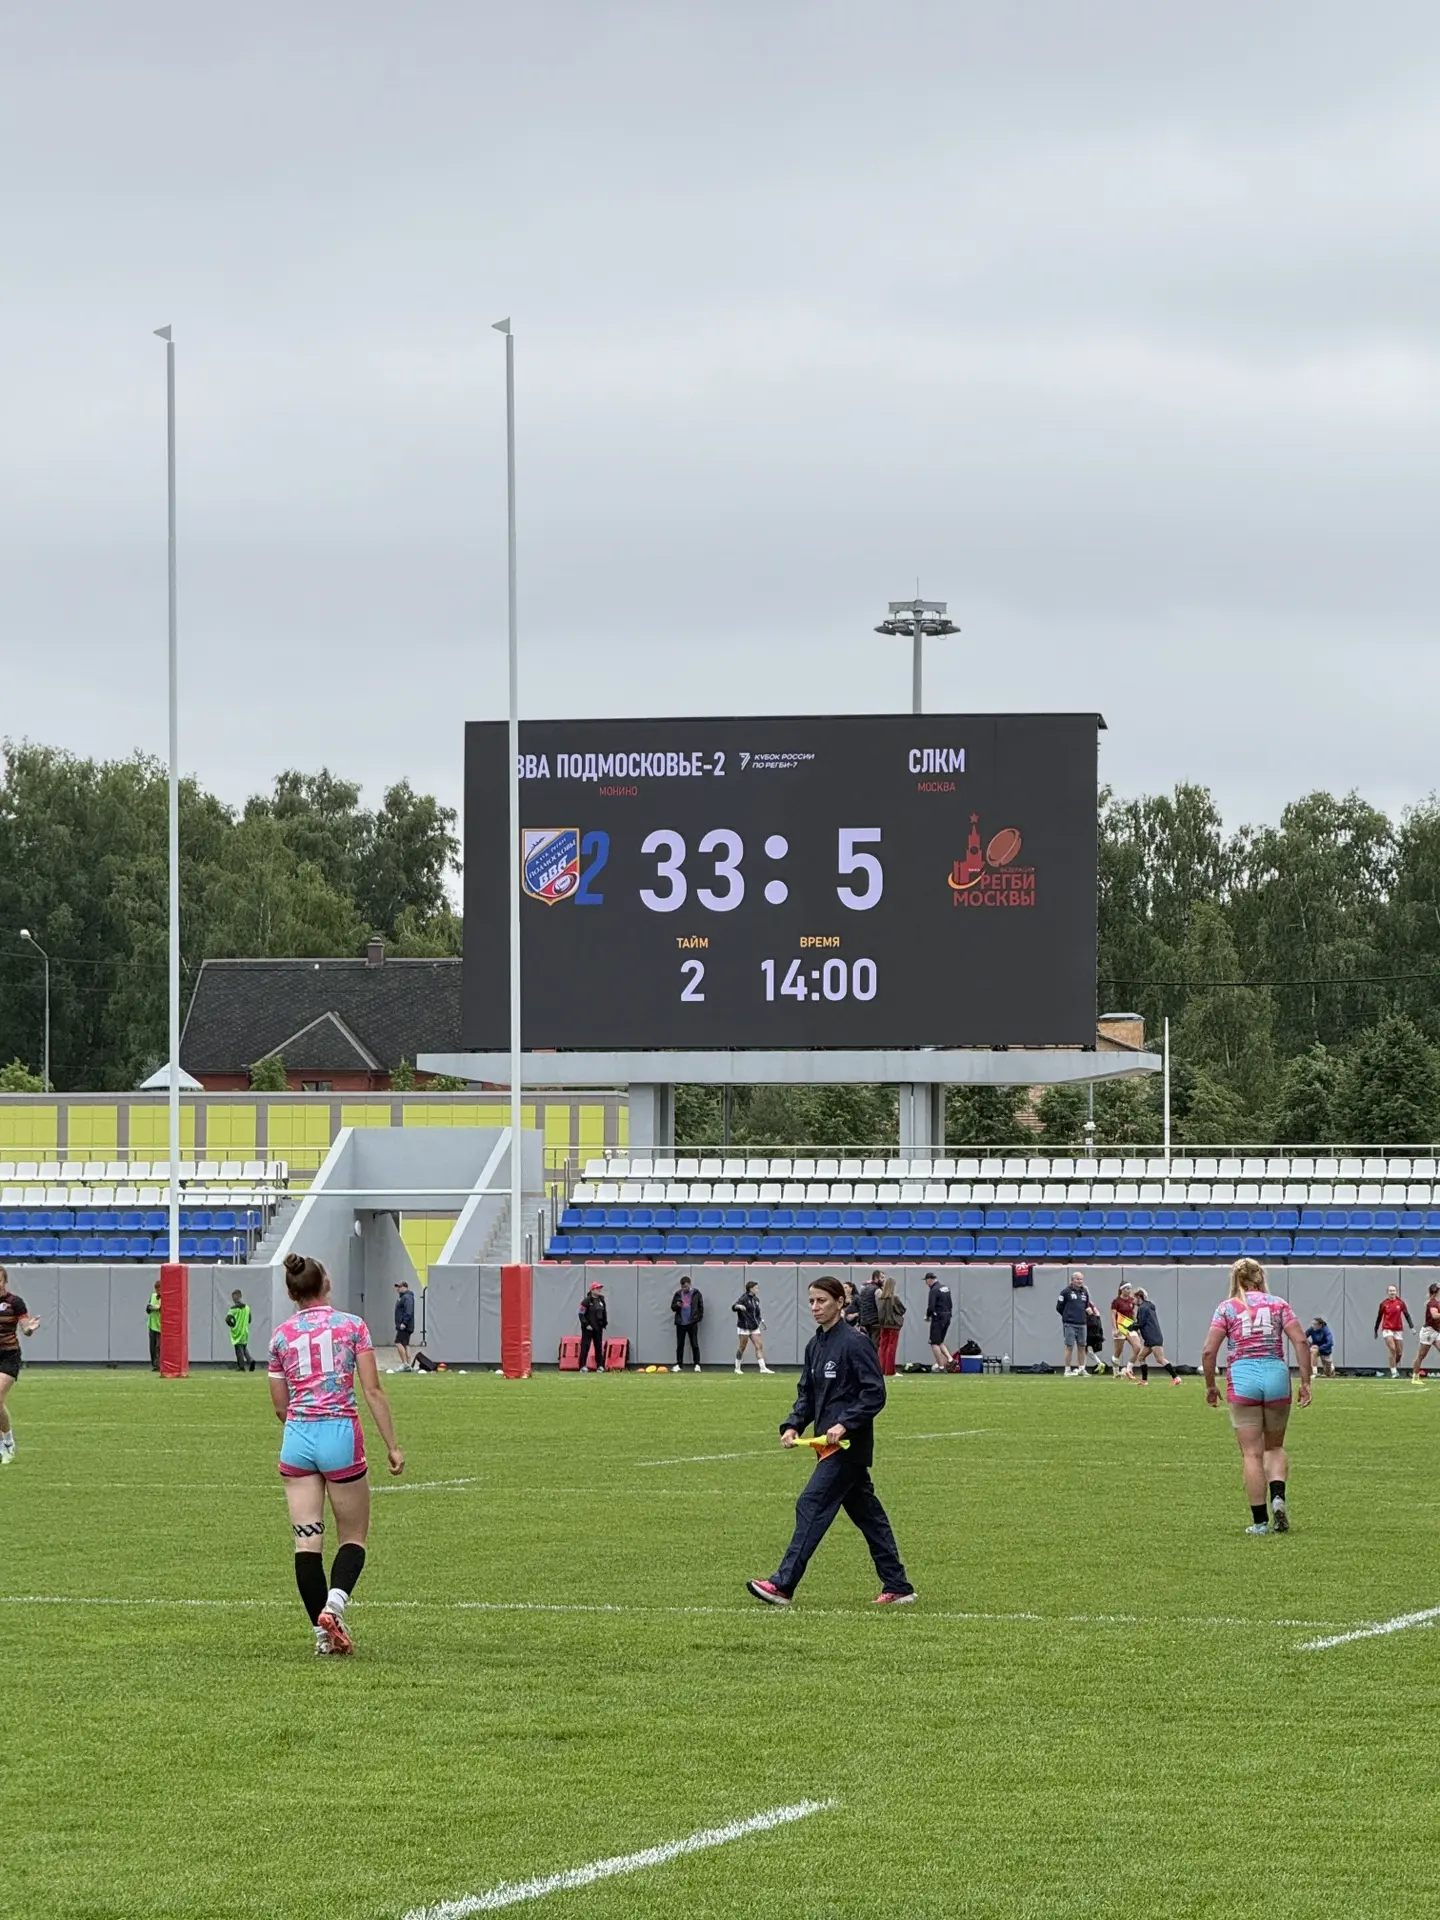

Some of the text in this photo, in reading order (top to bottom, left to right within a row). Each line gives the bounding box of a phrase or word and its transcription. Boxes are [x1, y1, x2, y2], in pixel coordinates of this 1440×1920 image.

[557, 751, 726, 782] ПОДМОСКОВЬЕ-2
[752, 761, 798, 769] ПО РЕГБИ-7
[908, 748, 966, 774] СЛКМ
[599, 786, 638, 796] МОНИНО
[917, 781, 956, 792] МОСКВА
[538, 854, 568, 887] ВВА
[574, 830, 610, 905] 2
[836, 827, 883, 911] 5
[980, 873, 1035, 890] РЕГБИ
[953, 890, 1035, 907] МОСКВЫ
[676, 935, 709, 949] ТАЙМ
[800, 936, 841, 948] ВРЕМЯ
[680, 959, 706, 1002] 2
[761, 958, 877, 1002] 14:00
[1236, 1306, 1274, 1337] 14
[288, 1329, 335, 1376] 11
